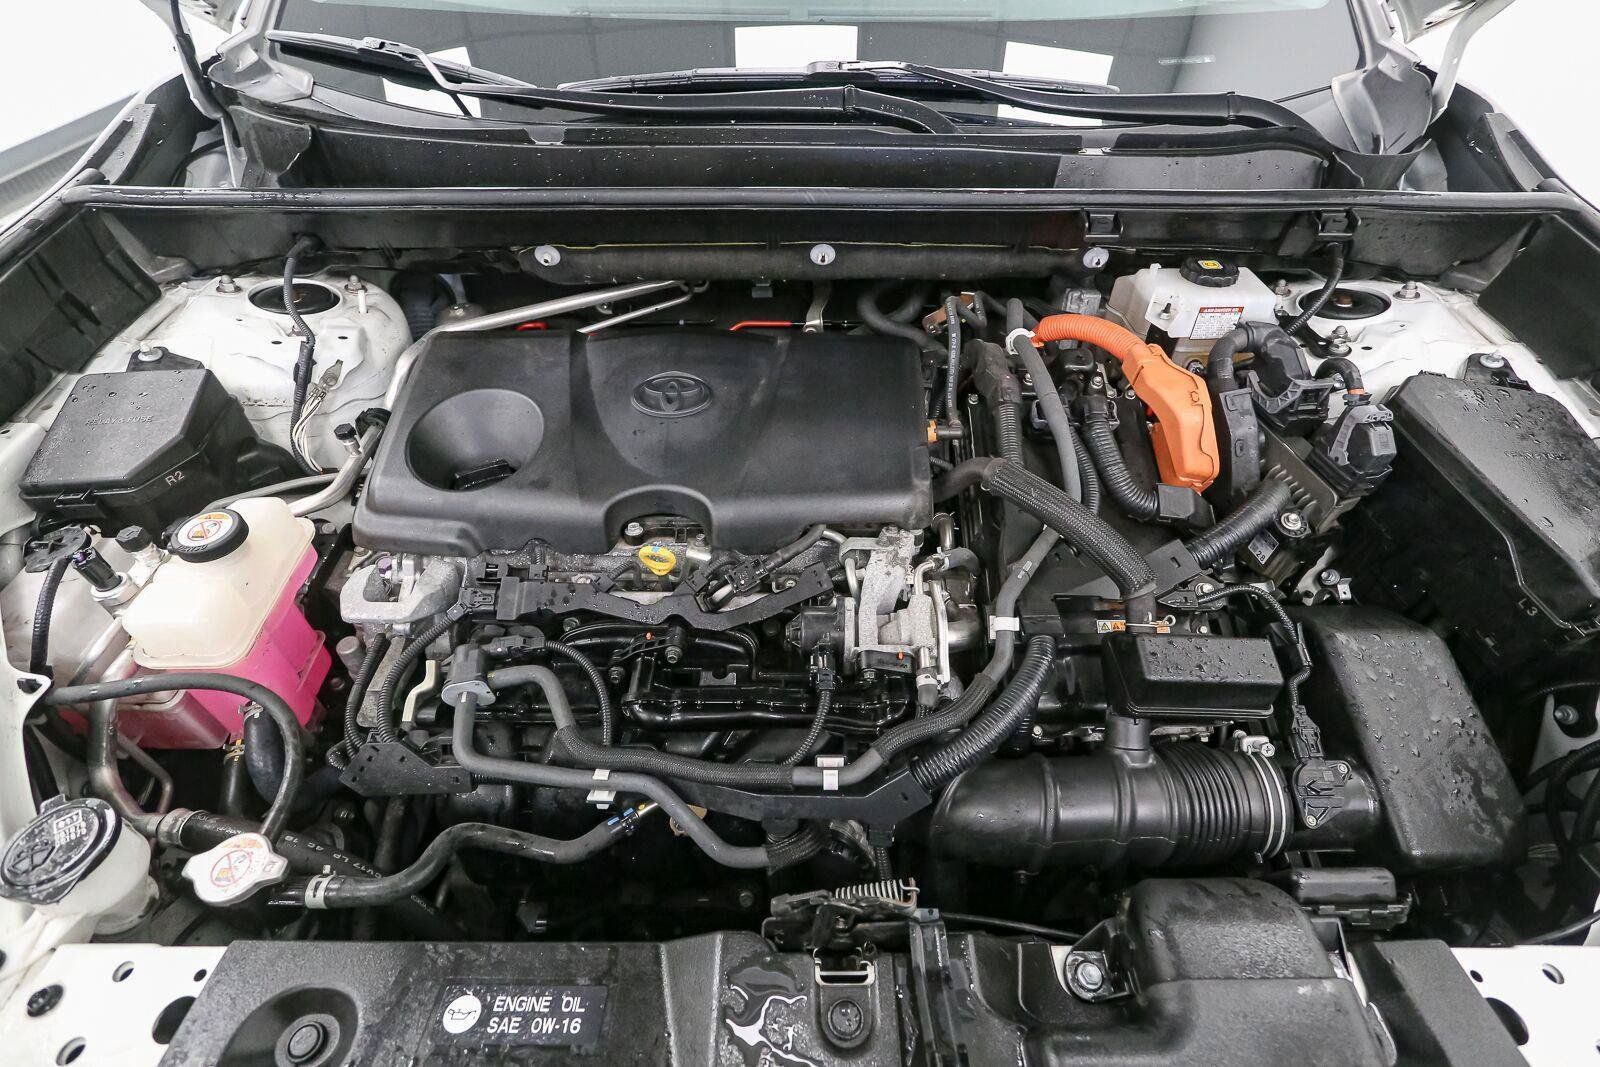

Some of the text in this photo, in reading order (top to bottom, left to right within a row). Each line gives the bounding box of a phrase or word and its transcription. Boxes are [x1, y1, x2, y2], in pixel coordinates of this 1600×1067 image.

[165, 470, 185, 487] R2
[493, 995, 586, 1012] ENGINE OIL
[486, 1017, 582, 1034] SAE 0W-16
